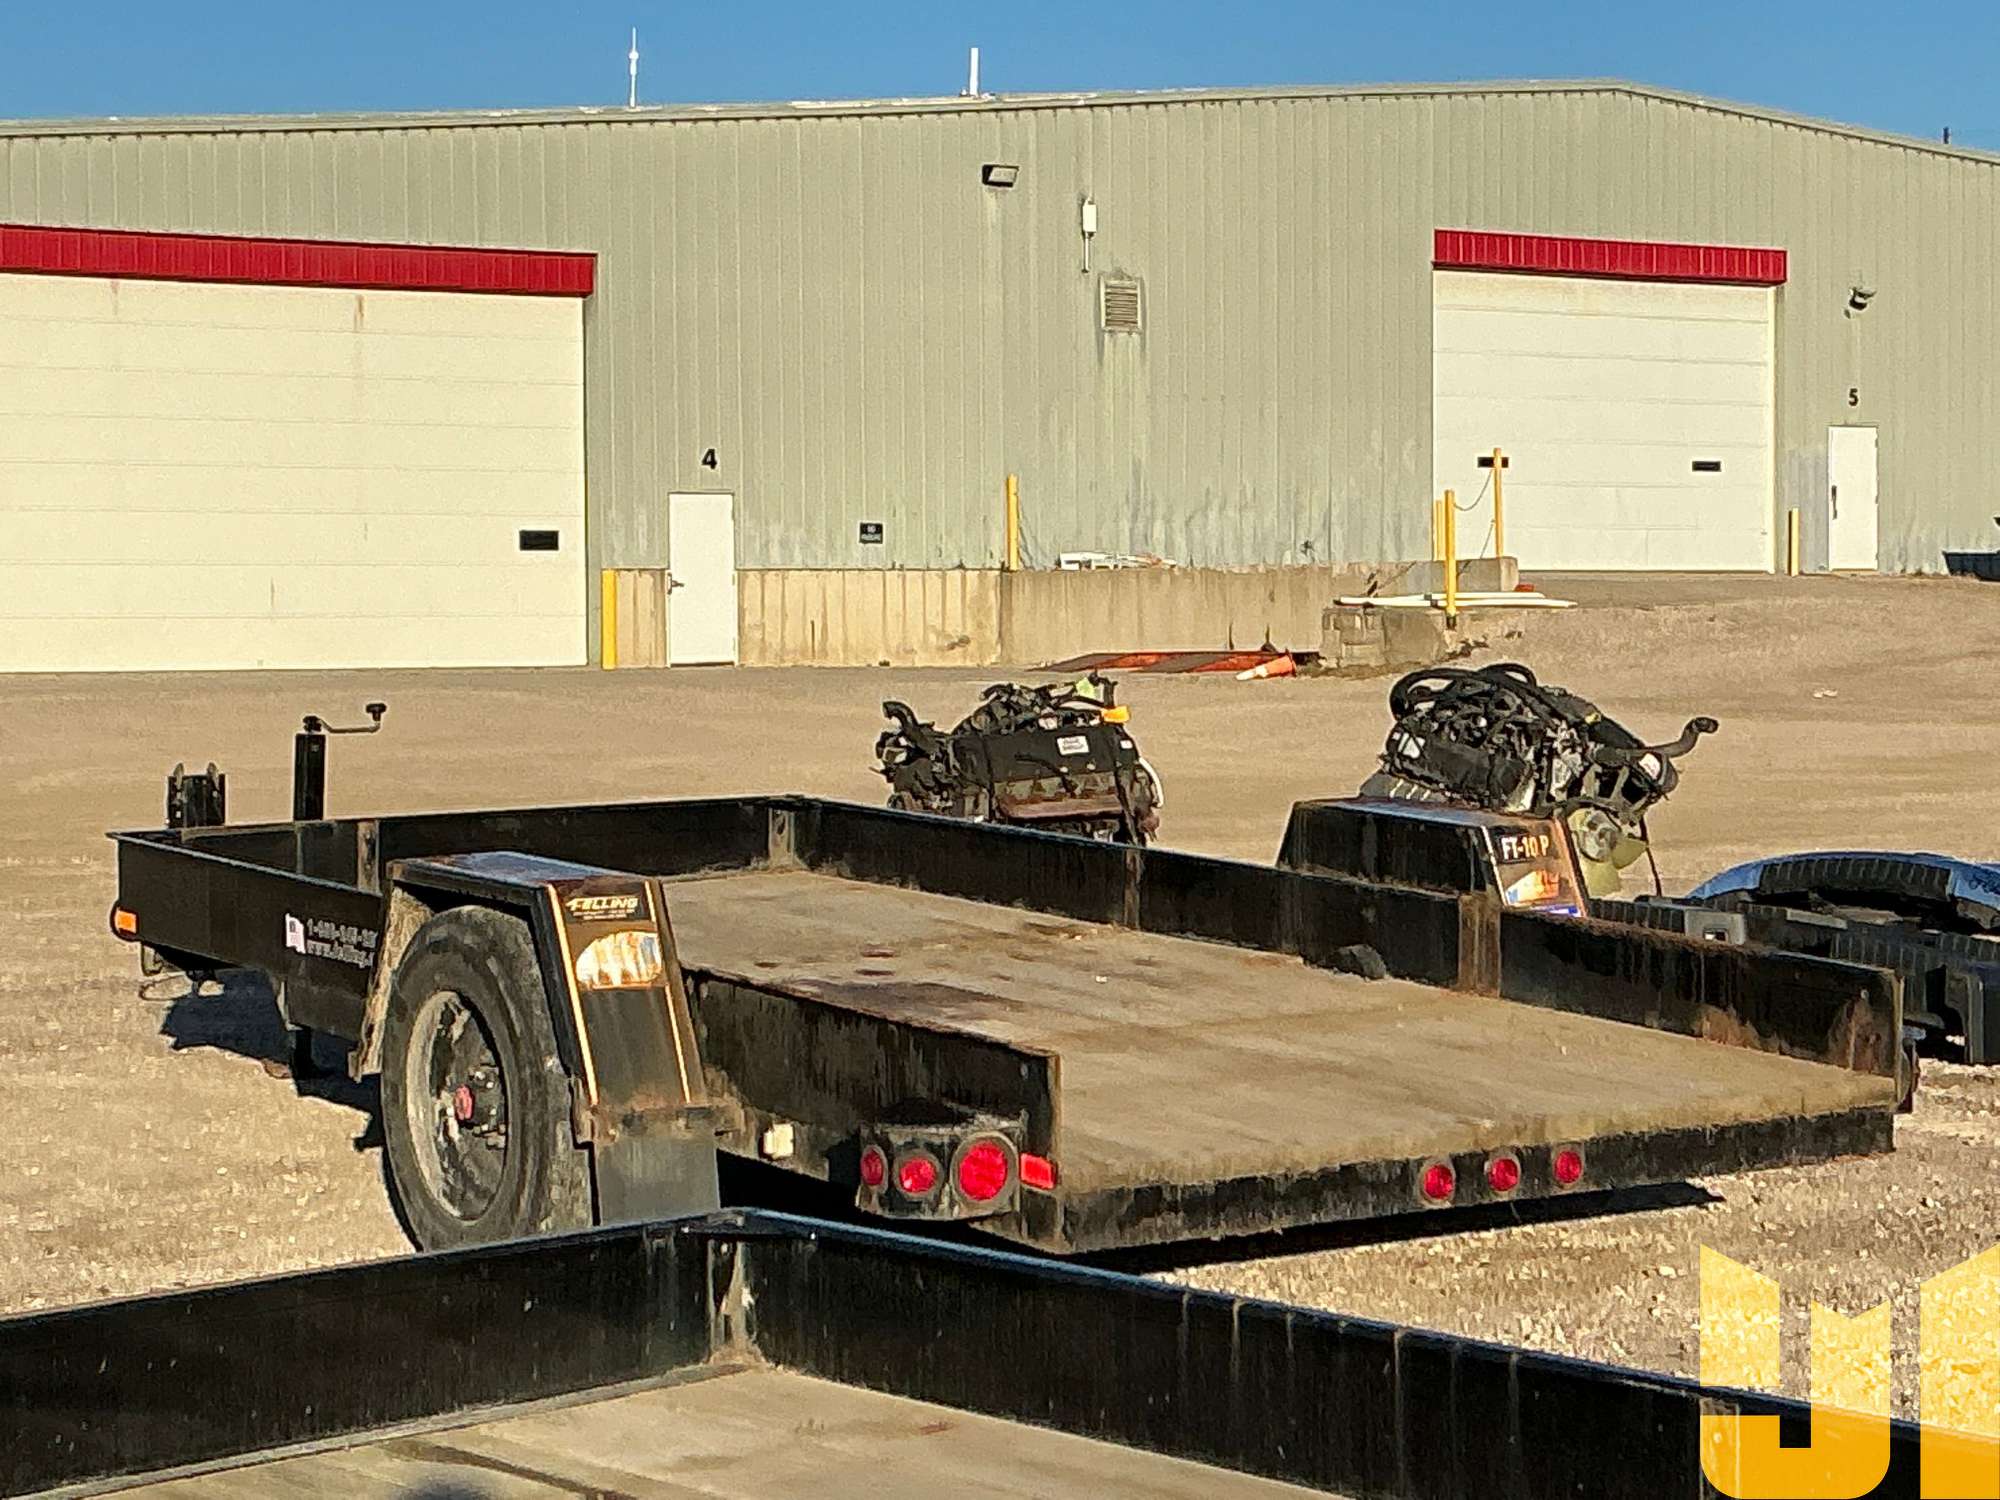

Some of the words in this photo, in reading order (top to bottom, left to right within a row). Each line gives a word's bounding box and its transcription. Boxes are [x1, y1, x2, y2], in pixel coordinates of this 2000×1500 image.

[1848, 387, 1859, 407] 5
[701, 448, 718, 470] 4
[565, 895, 639, 911] FELLING
